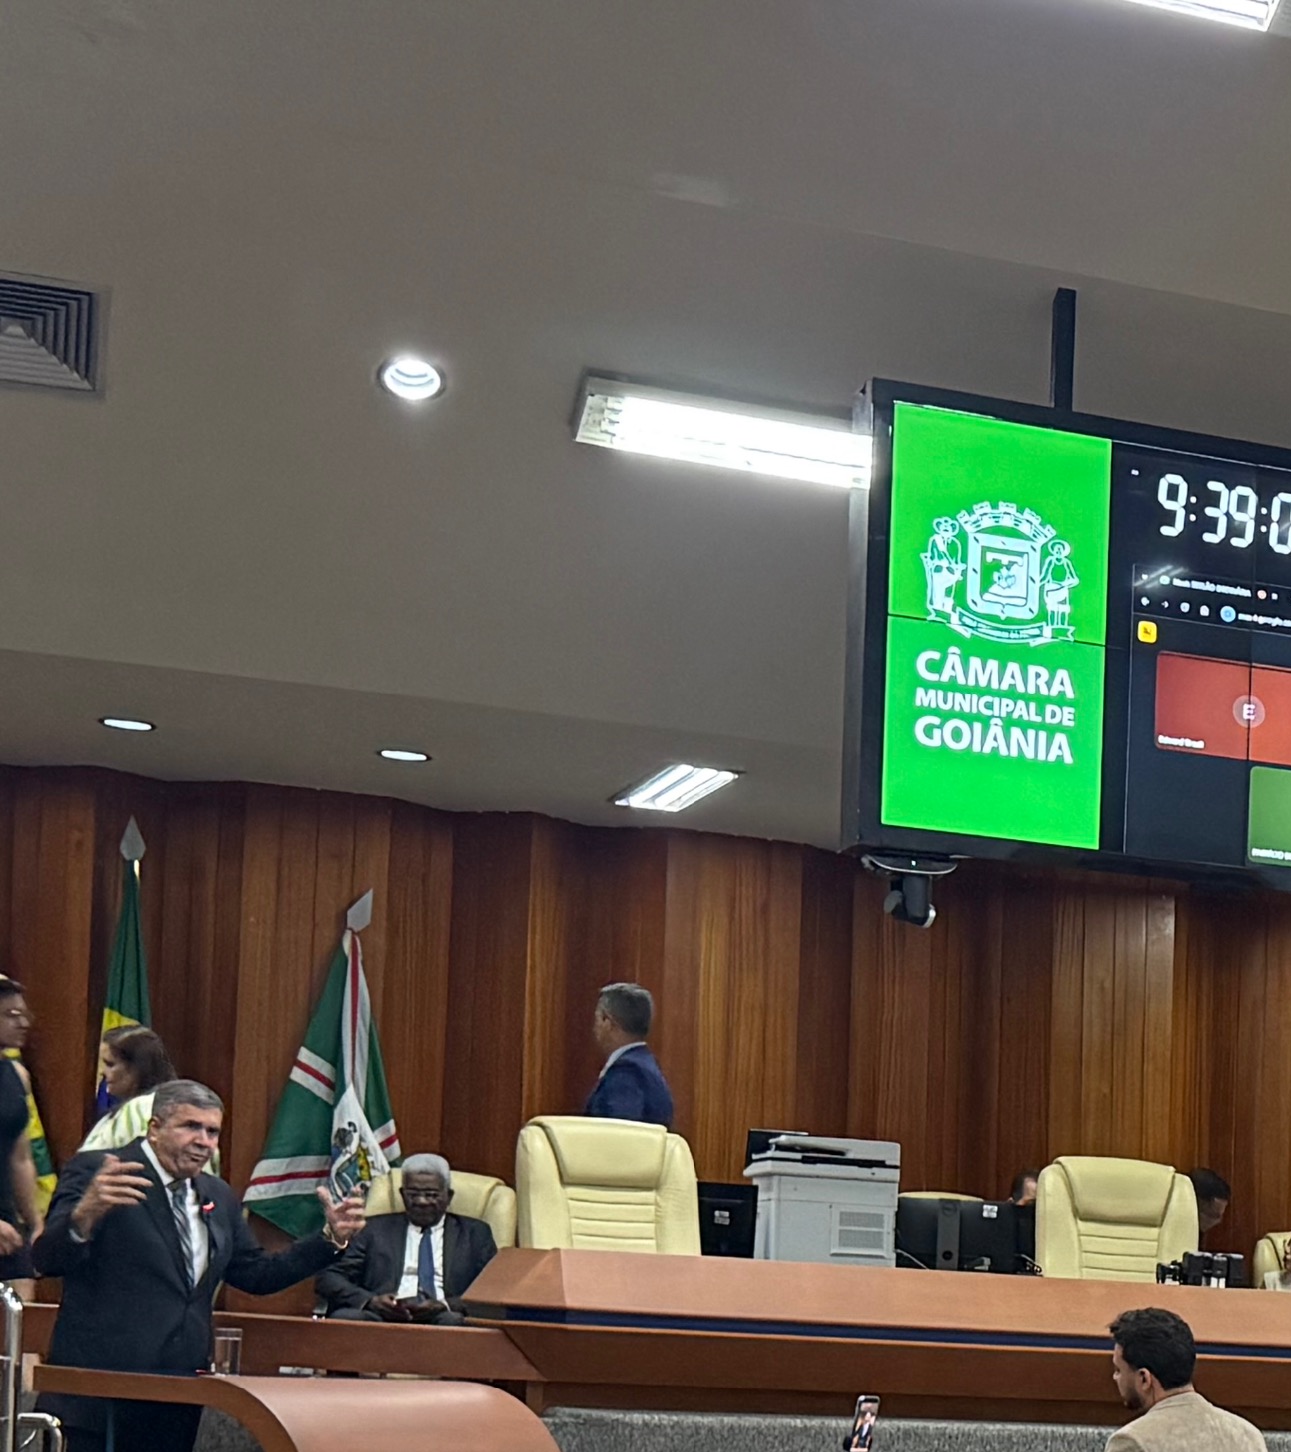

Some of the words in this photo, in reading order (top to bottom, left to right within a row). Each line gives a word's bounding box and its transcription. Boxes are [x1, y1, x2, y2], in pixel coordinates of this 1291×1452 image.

[915, 646, 1075, 699] CÂMARA
[915, 687, 1042, 723] MUNICIPAL
[1045, 704, 1075, 727] DE
[1242, 703, 1256, 721] E
[914, 715, 1074, 764] GOIÂNIA
